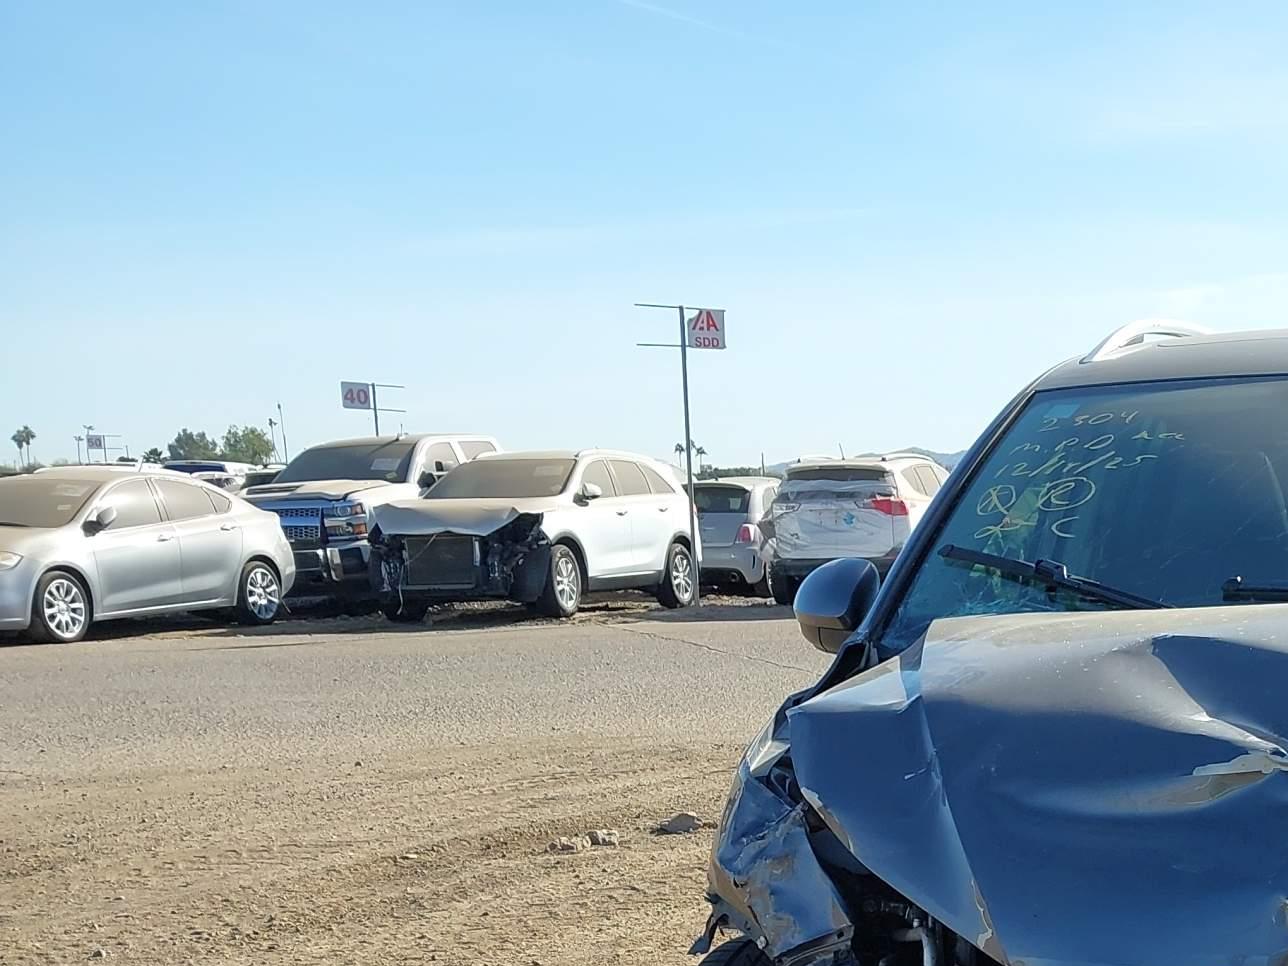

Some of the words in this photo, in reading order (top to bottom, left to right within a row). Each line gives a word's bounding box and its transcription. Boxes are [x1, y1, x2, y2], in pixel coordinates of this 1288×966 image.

[694, 336, 720, 348] SDD
[343, 387, 369, 405] 40
[87, 437, 102, 448] 50
